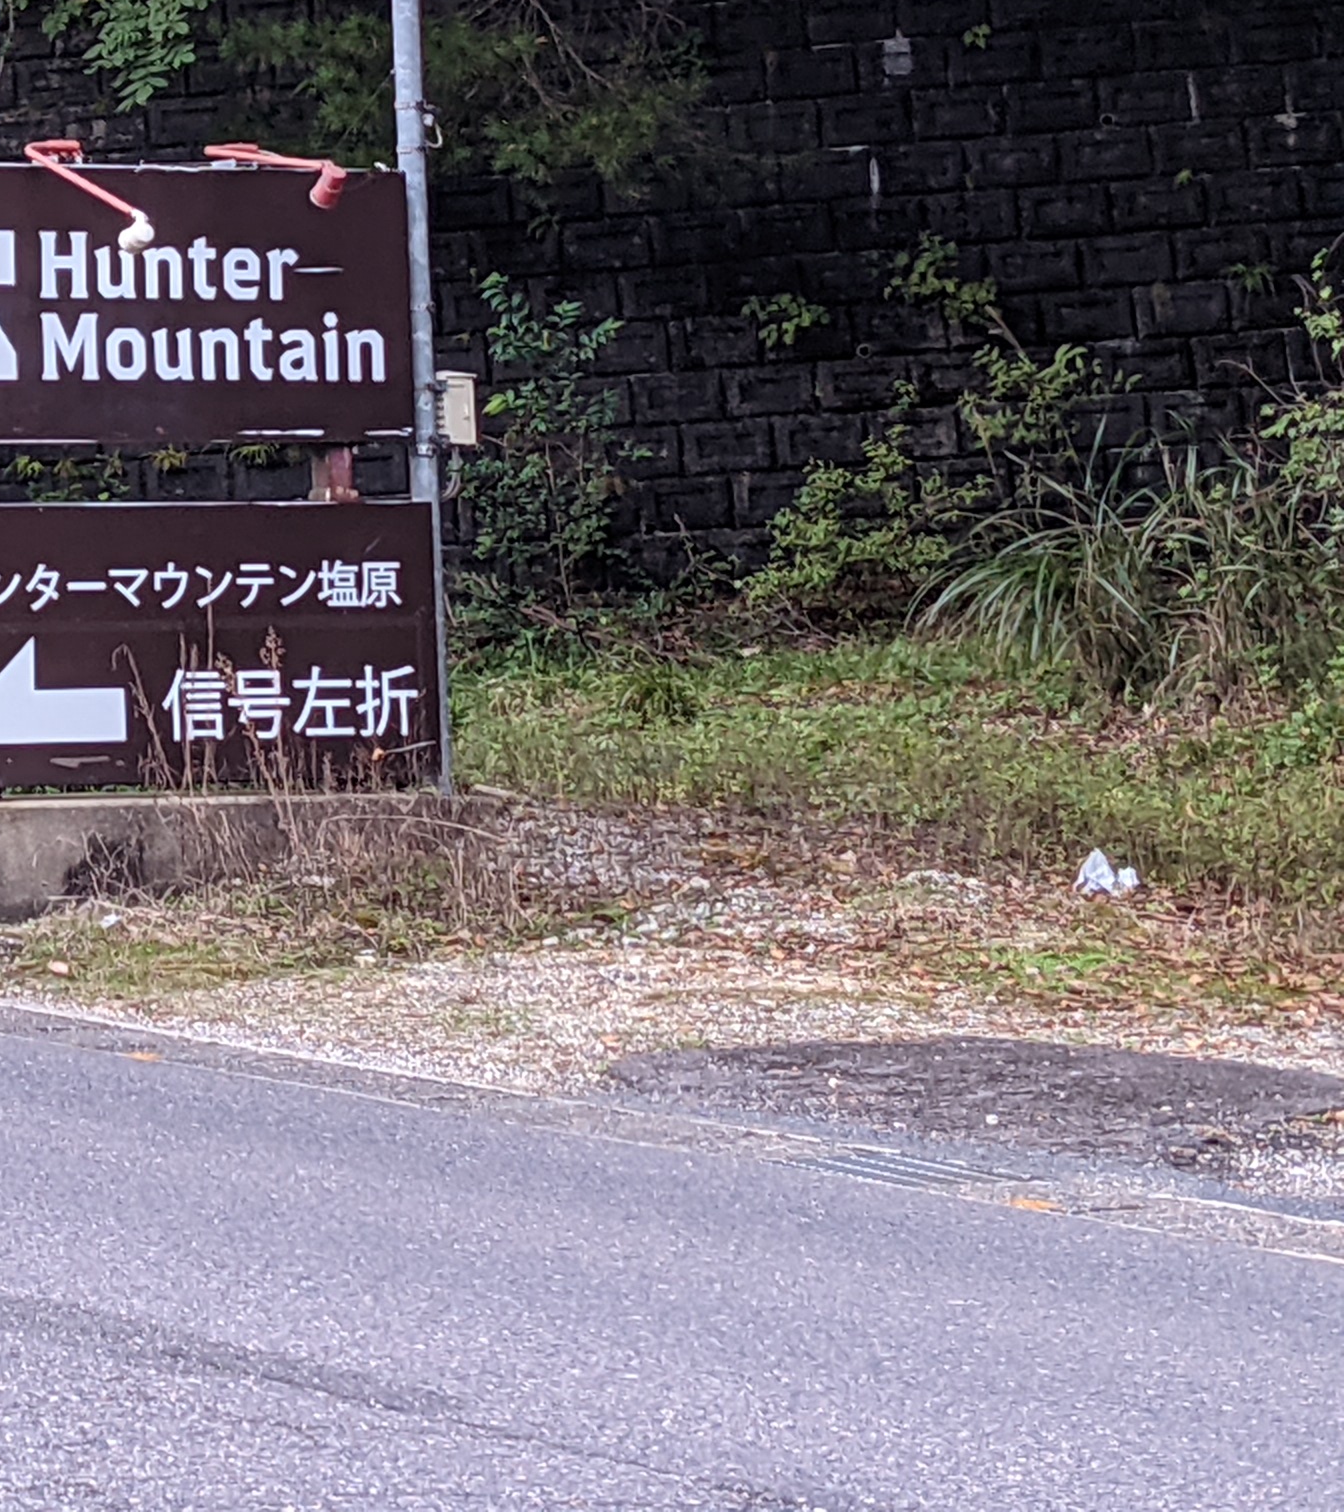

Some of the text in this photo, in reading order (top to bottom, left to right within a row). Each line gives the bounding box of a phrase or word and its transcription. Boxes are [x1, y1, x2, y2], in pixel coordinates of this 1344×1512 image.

[38, 230, 300, 301] Hunter
[40, 311, 386, 382] Mountain
[162, 665, 419, 742] 信号左折
